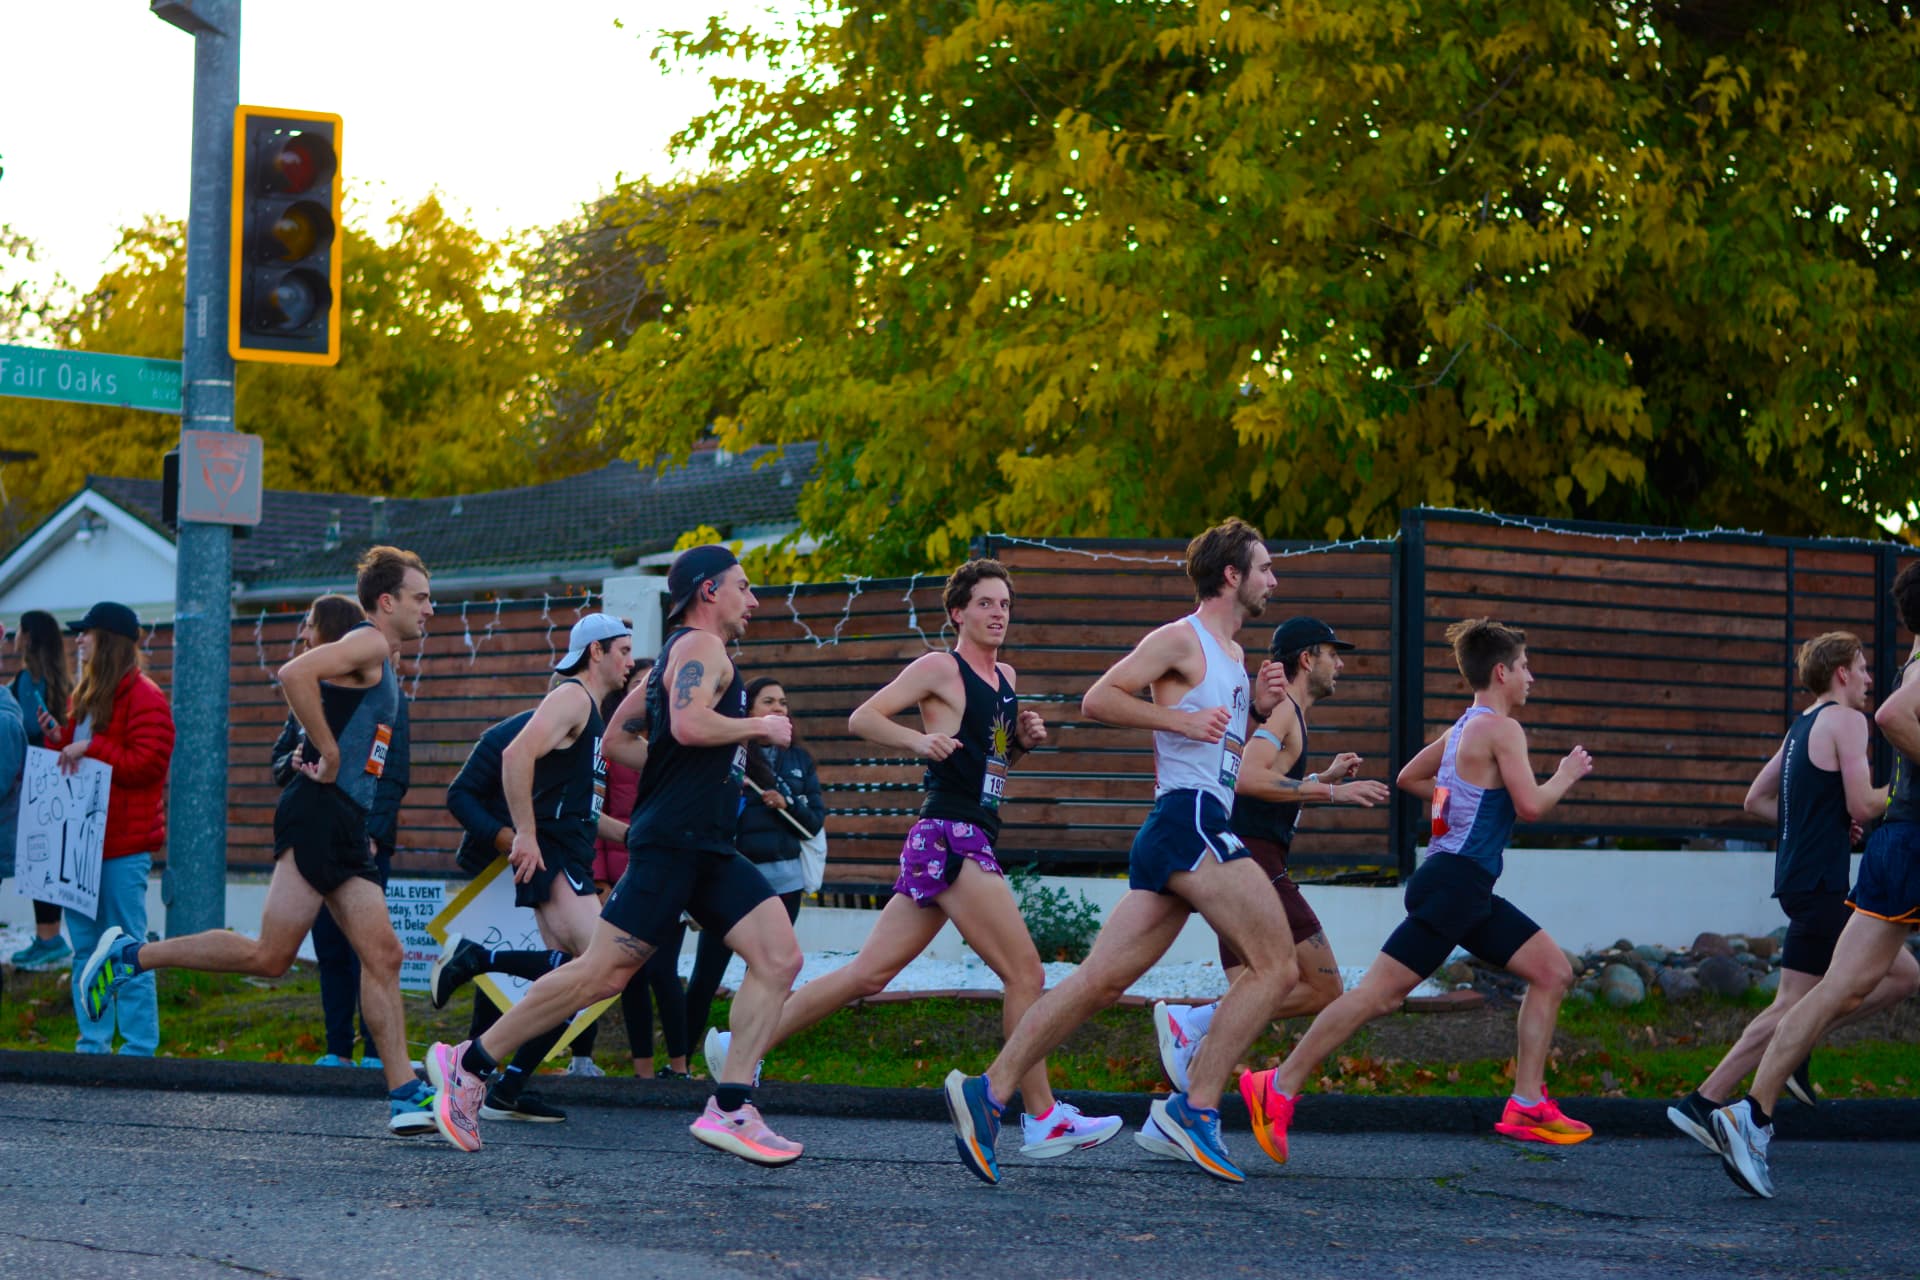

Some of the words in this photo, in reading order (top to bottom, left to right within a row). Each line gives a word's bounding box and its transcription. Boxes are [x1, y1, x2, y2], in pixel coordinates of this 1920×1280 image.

[0, 358, 46, 388] Fair
[57, 363, 117, 395] Oaks
[409, 886, 441, 899] EVENT
[414, 903, 434, 916] 12/3
